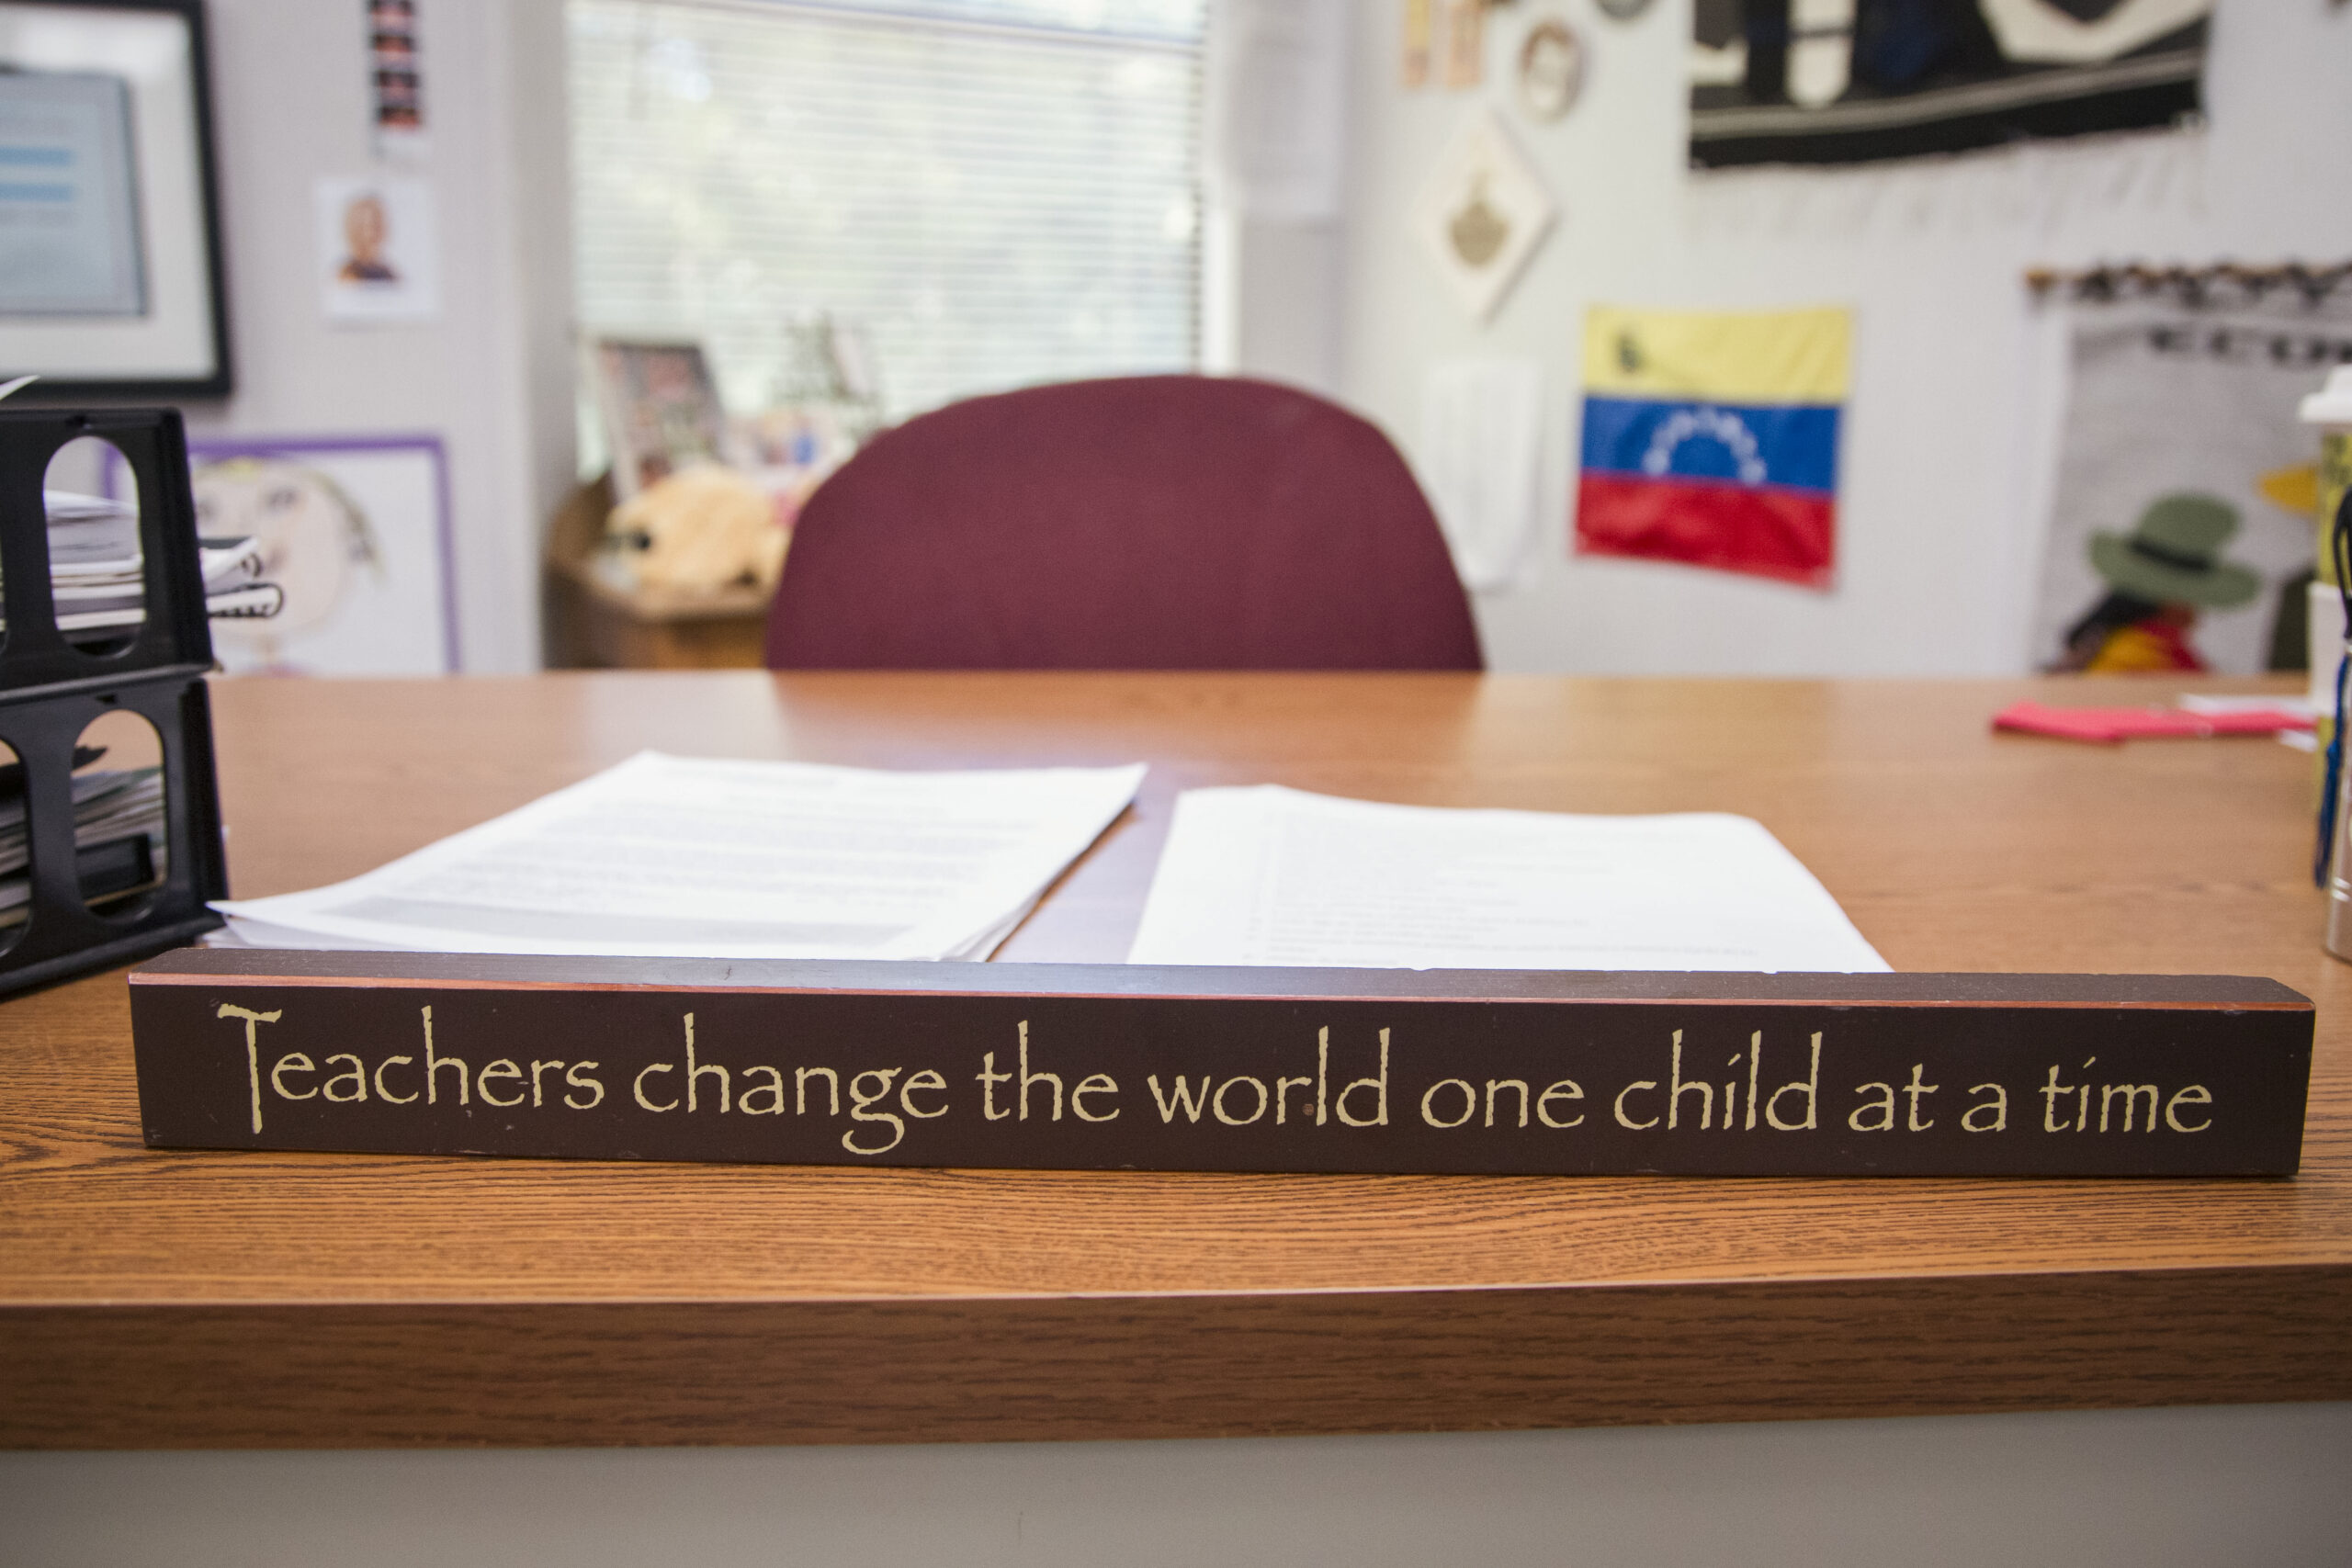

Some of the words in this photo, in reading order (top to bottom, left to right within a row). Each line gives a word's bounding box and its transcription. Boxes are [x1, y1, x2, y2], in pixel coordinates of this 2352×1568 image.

[218, 1004, 605, 1133] Teachers
[634, 1013, 949, 1156] change
[976, 1021, 1120, 1122] the
[1148, 1026, 1390, 1128] world
[1422, 1079, 1585, 1129] one
[1614, 1030, 1823, 1132] child
[1848, 1064, 1939, 1133] at
[1962, 1084, 2007, 1133] a
[2040, 1057, 2211, 1134] time
